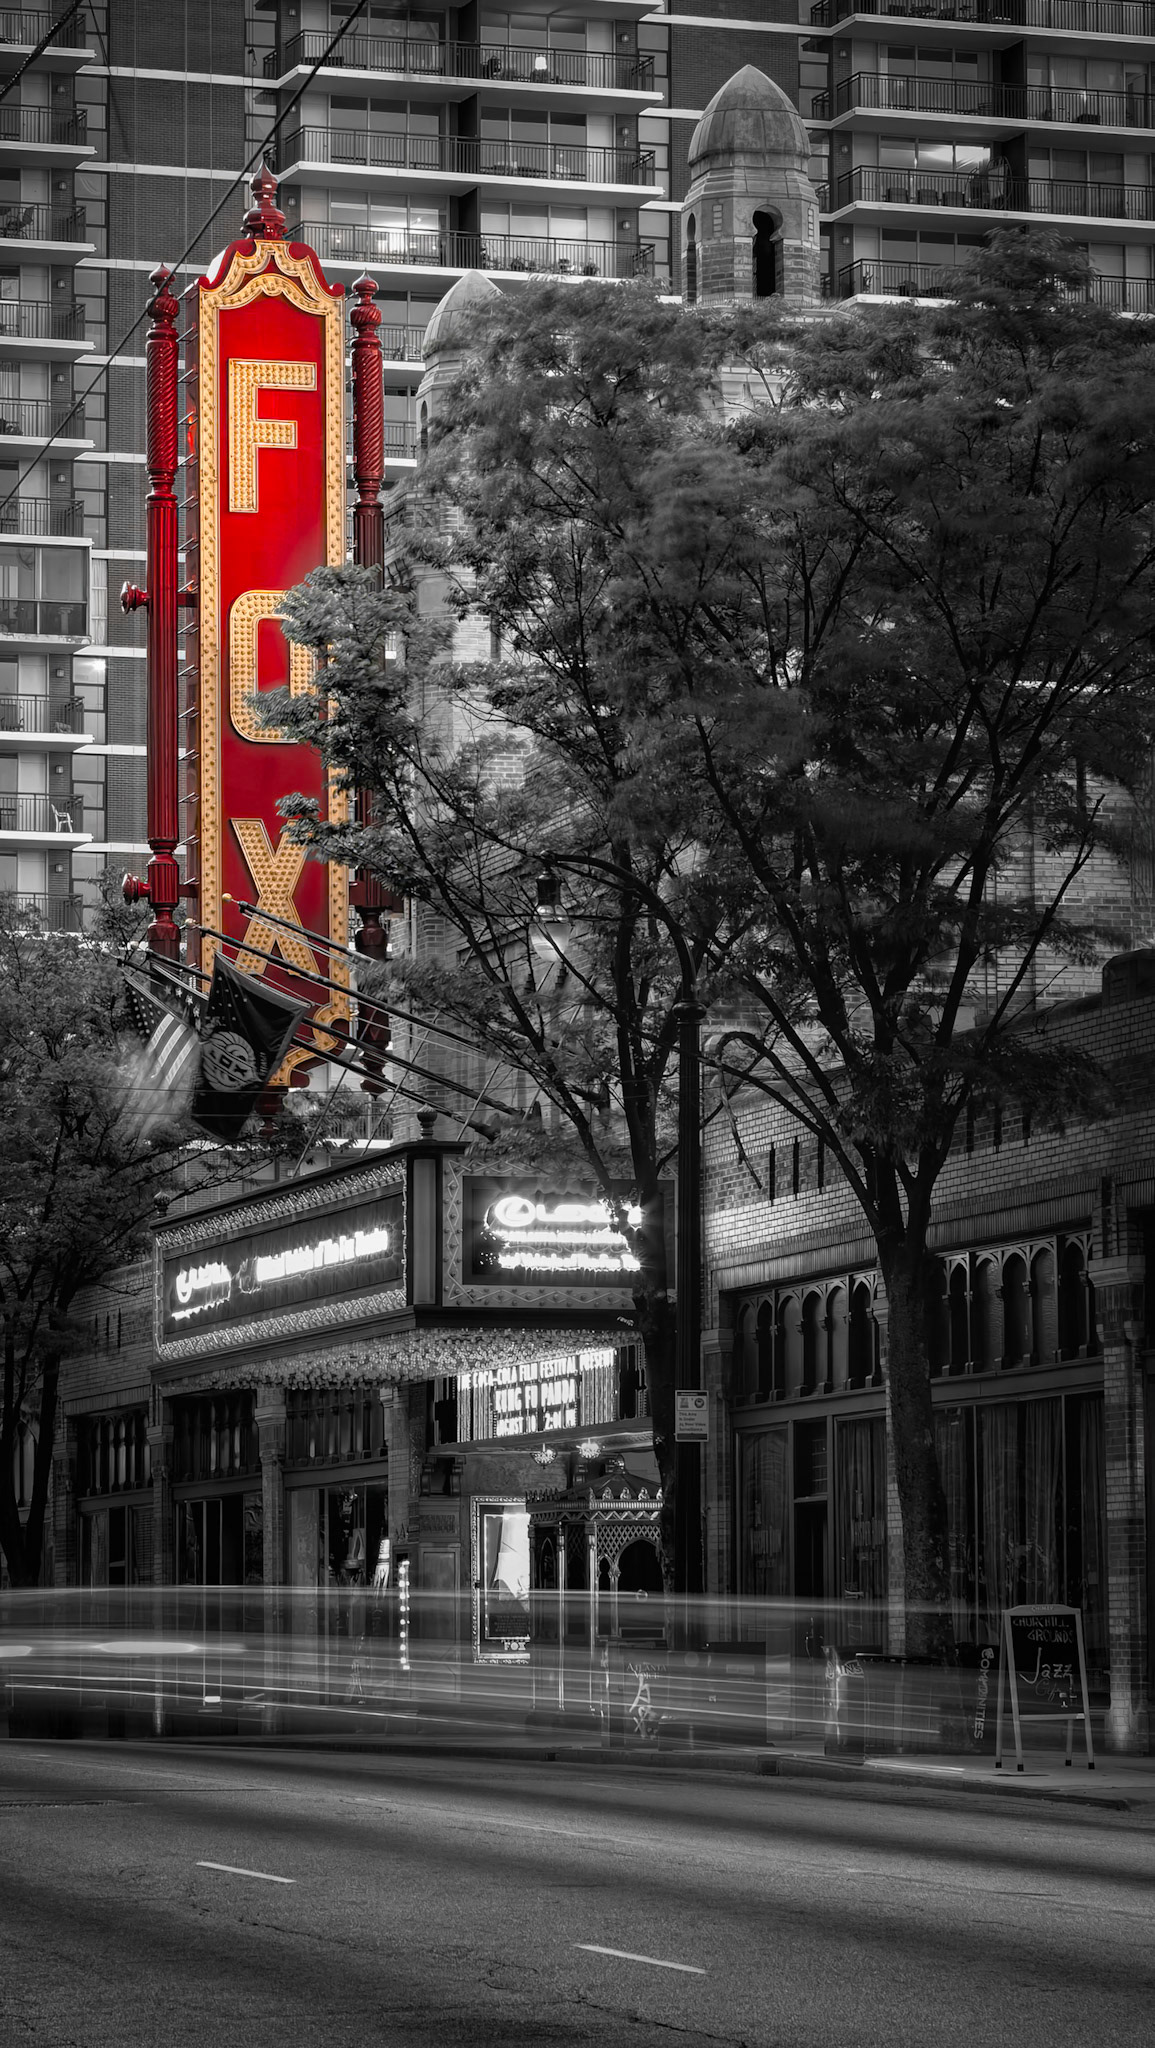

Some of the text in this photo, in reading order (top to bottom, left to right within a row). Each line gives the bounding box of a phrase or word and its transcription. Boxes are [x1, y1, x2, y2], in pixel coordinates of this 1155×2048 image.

[228, 358, 320, 976] FOX
[473, 1366, 518, 1389] COCA-COLA
[519, 1362, 538, 1382] FILM
[540, 1356, 577, 1379] FESTIVAL
[495, 1379, 576, 1413] KUNG FU PANDA
[1012, 1616, 1070, 1628] CHURCHILL
[504, 1642, 527, 1651] FOX
[1027, 1628, 1074, 1644] GROUNDS
